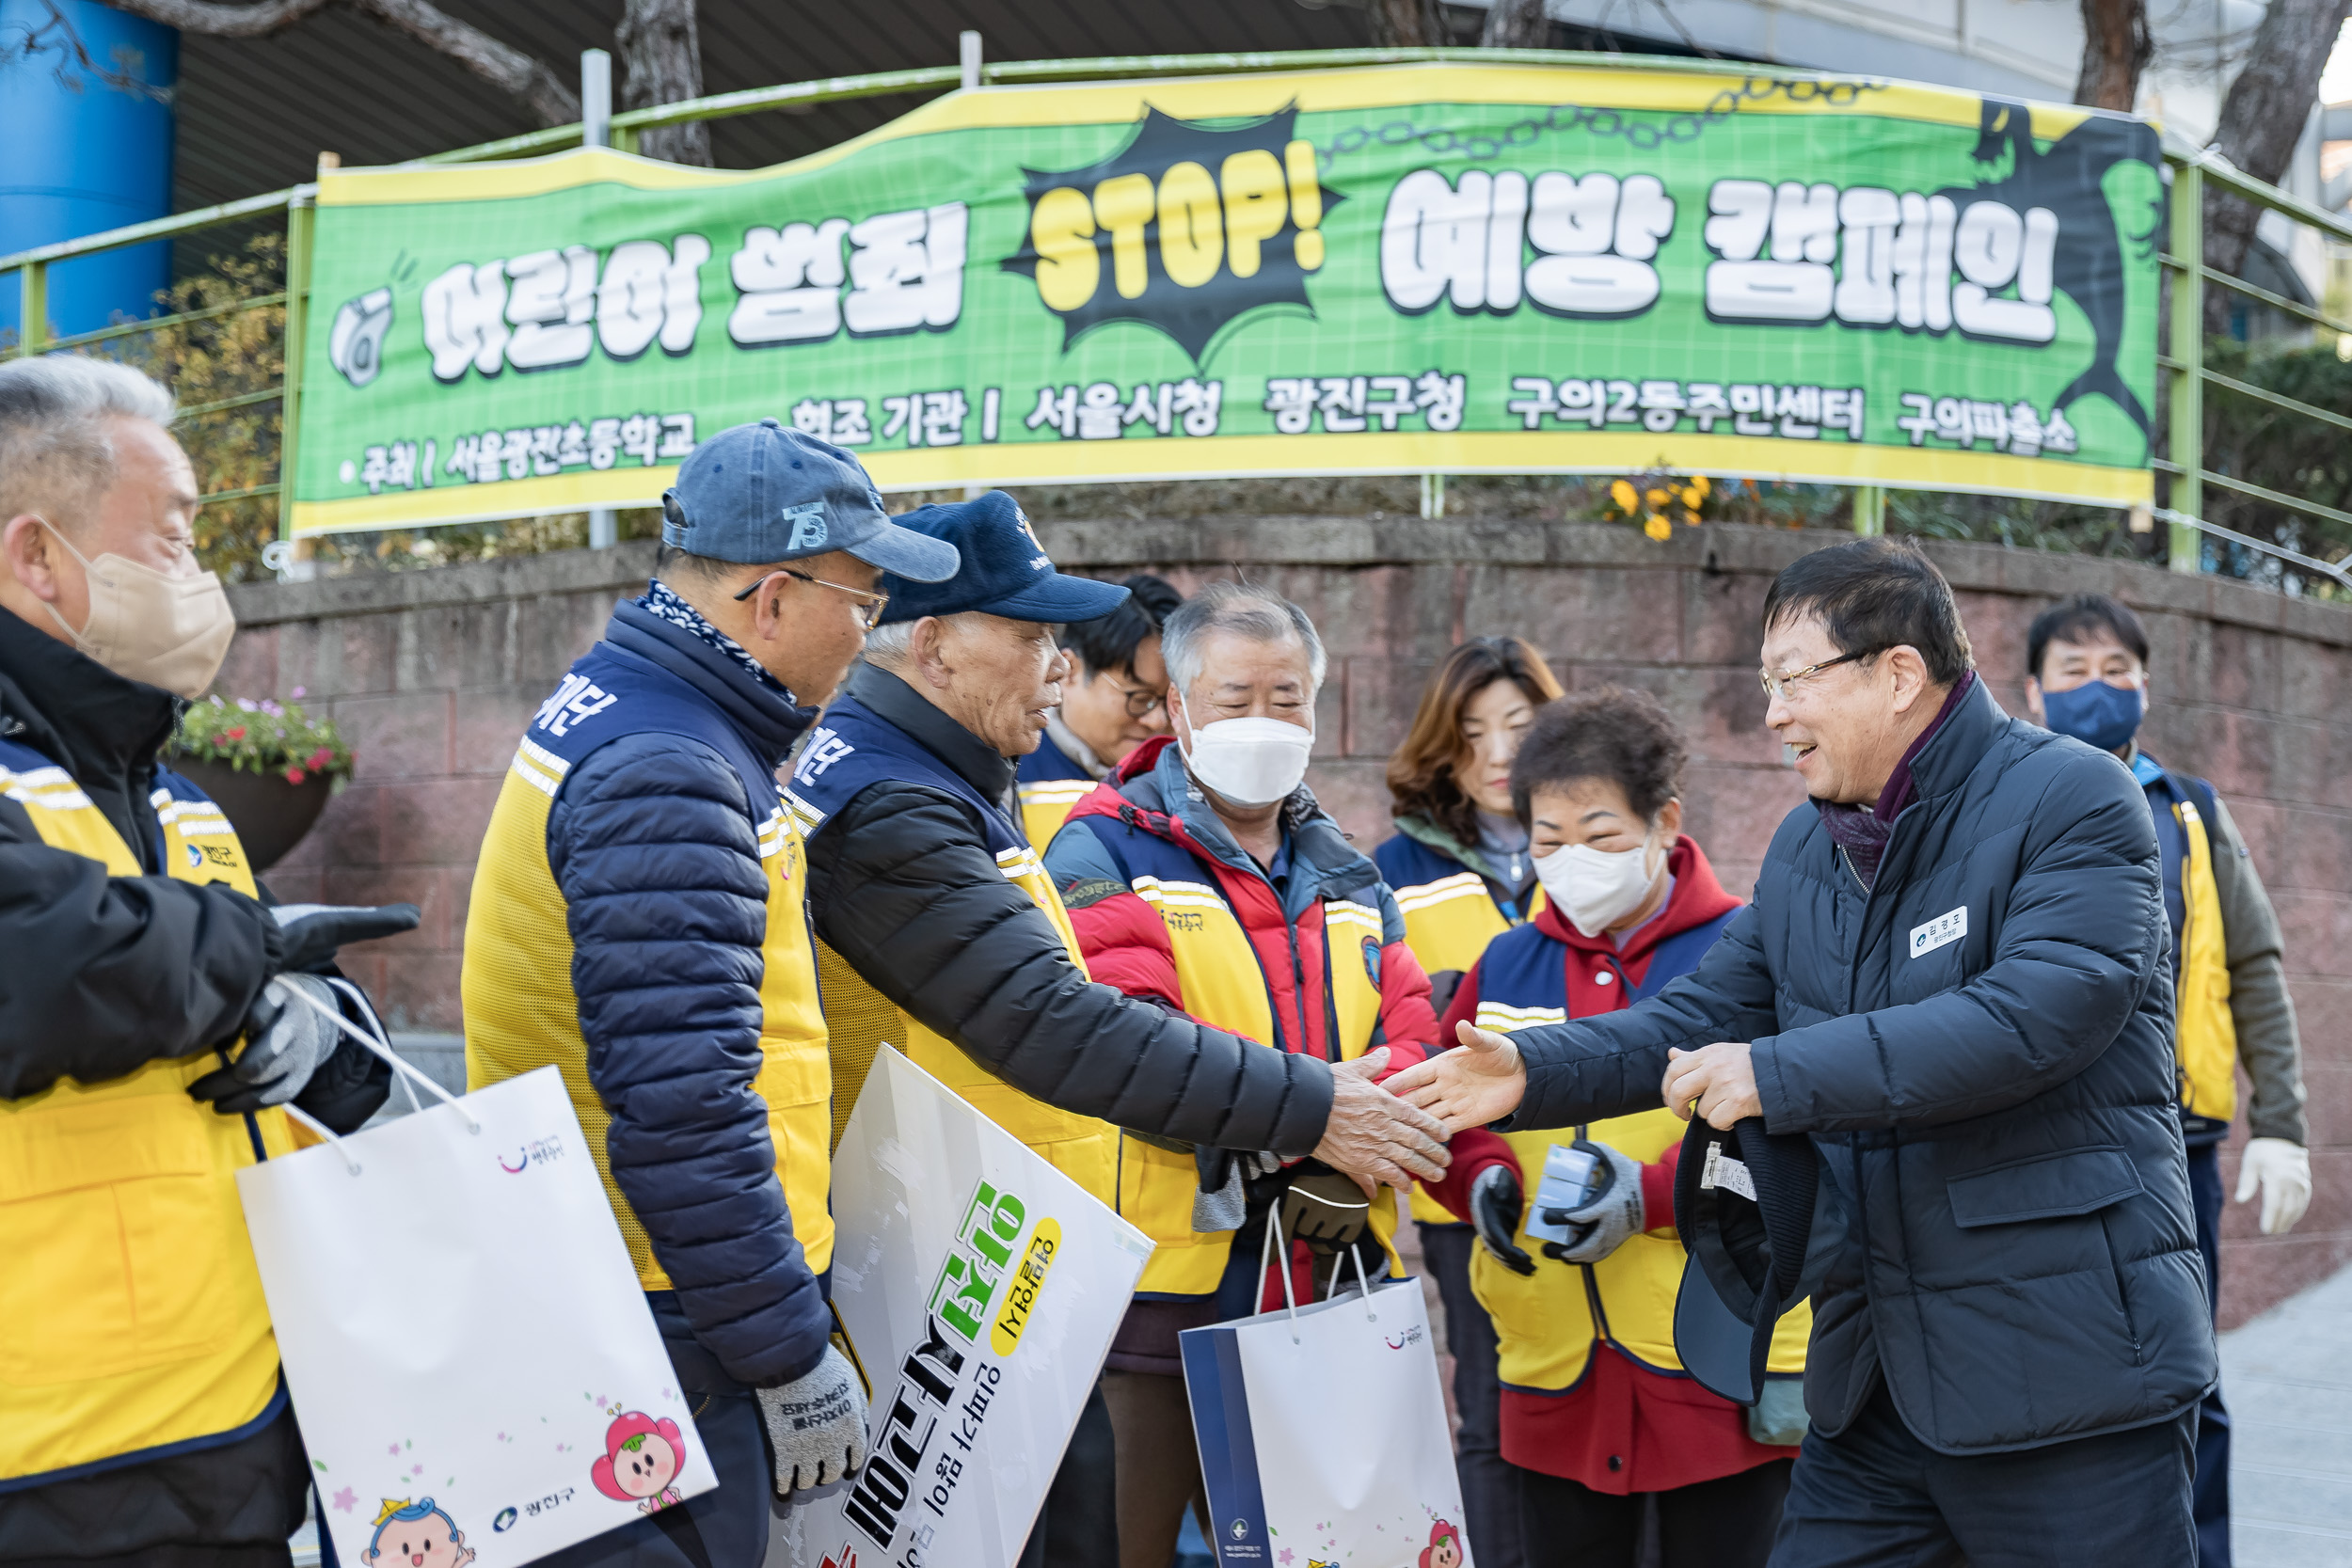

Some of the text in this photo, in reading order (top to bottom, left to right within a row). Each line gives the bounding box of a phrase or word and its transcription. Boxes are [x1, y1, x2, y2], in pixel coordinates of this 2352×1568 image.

[422, 139, 2059, 384] 어린이 범죄 STOP! 예방 캠페인
[361, 440, 418, 495] 주최
[445, 412, 697, 483] 서울광진초등학교
[882, 388, 970, 448] 기관
[1025, 378, 1223, 440] 서울시청
[1264, 369, 1467, 436] 광진구청
[1507, 377, 1866, 442] 구의2동주민센터
[1898, 390, 2080, 459] 구의파출소
[998, 1236, 1055, 1339] 연말연시
[842, 1177, 1026, 1555] 안전사고에
[949, 1361, 1001, 1453] 인파가
[923, 1451, 964, 1517] 많이
